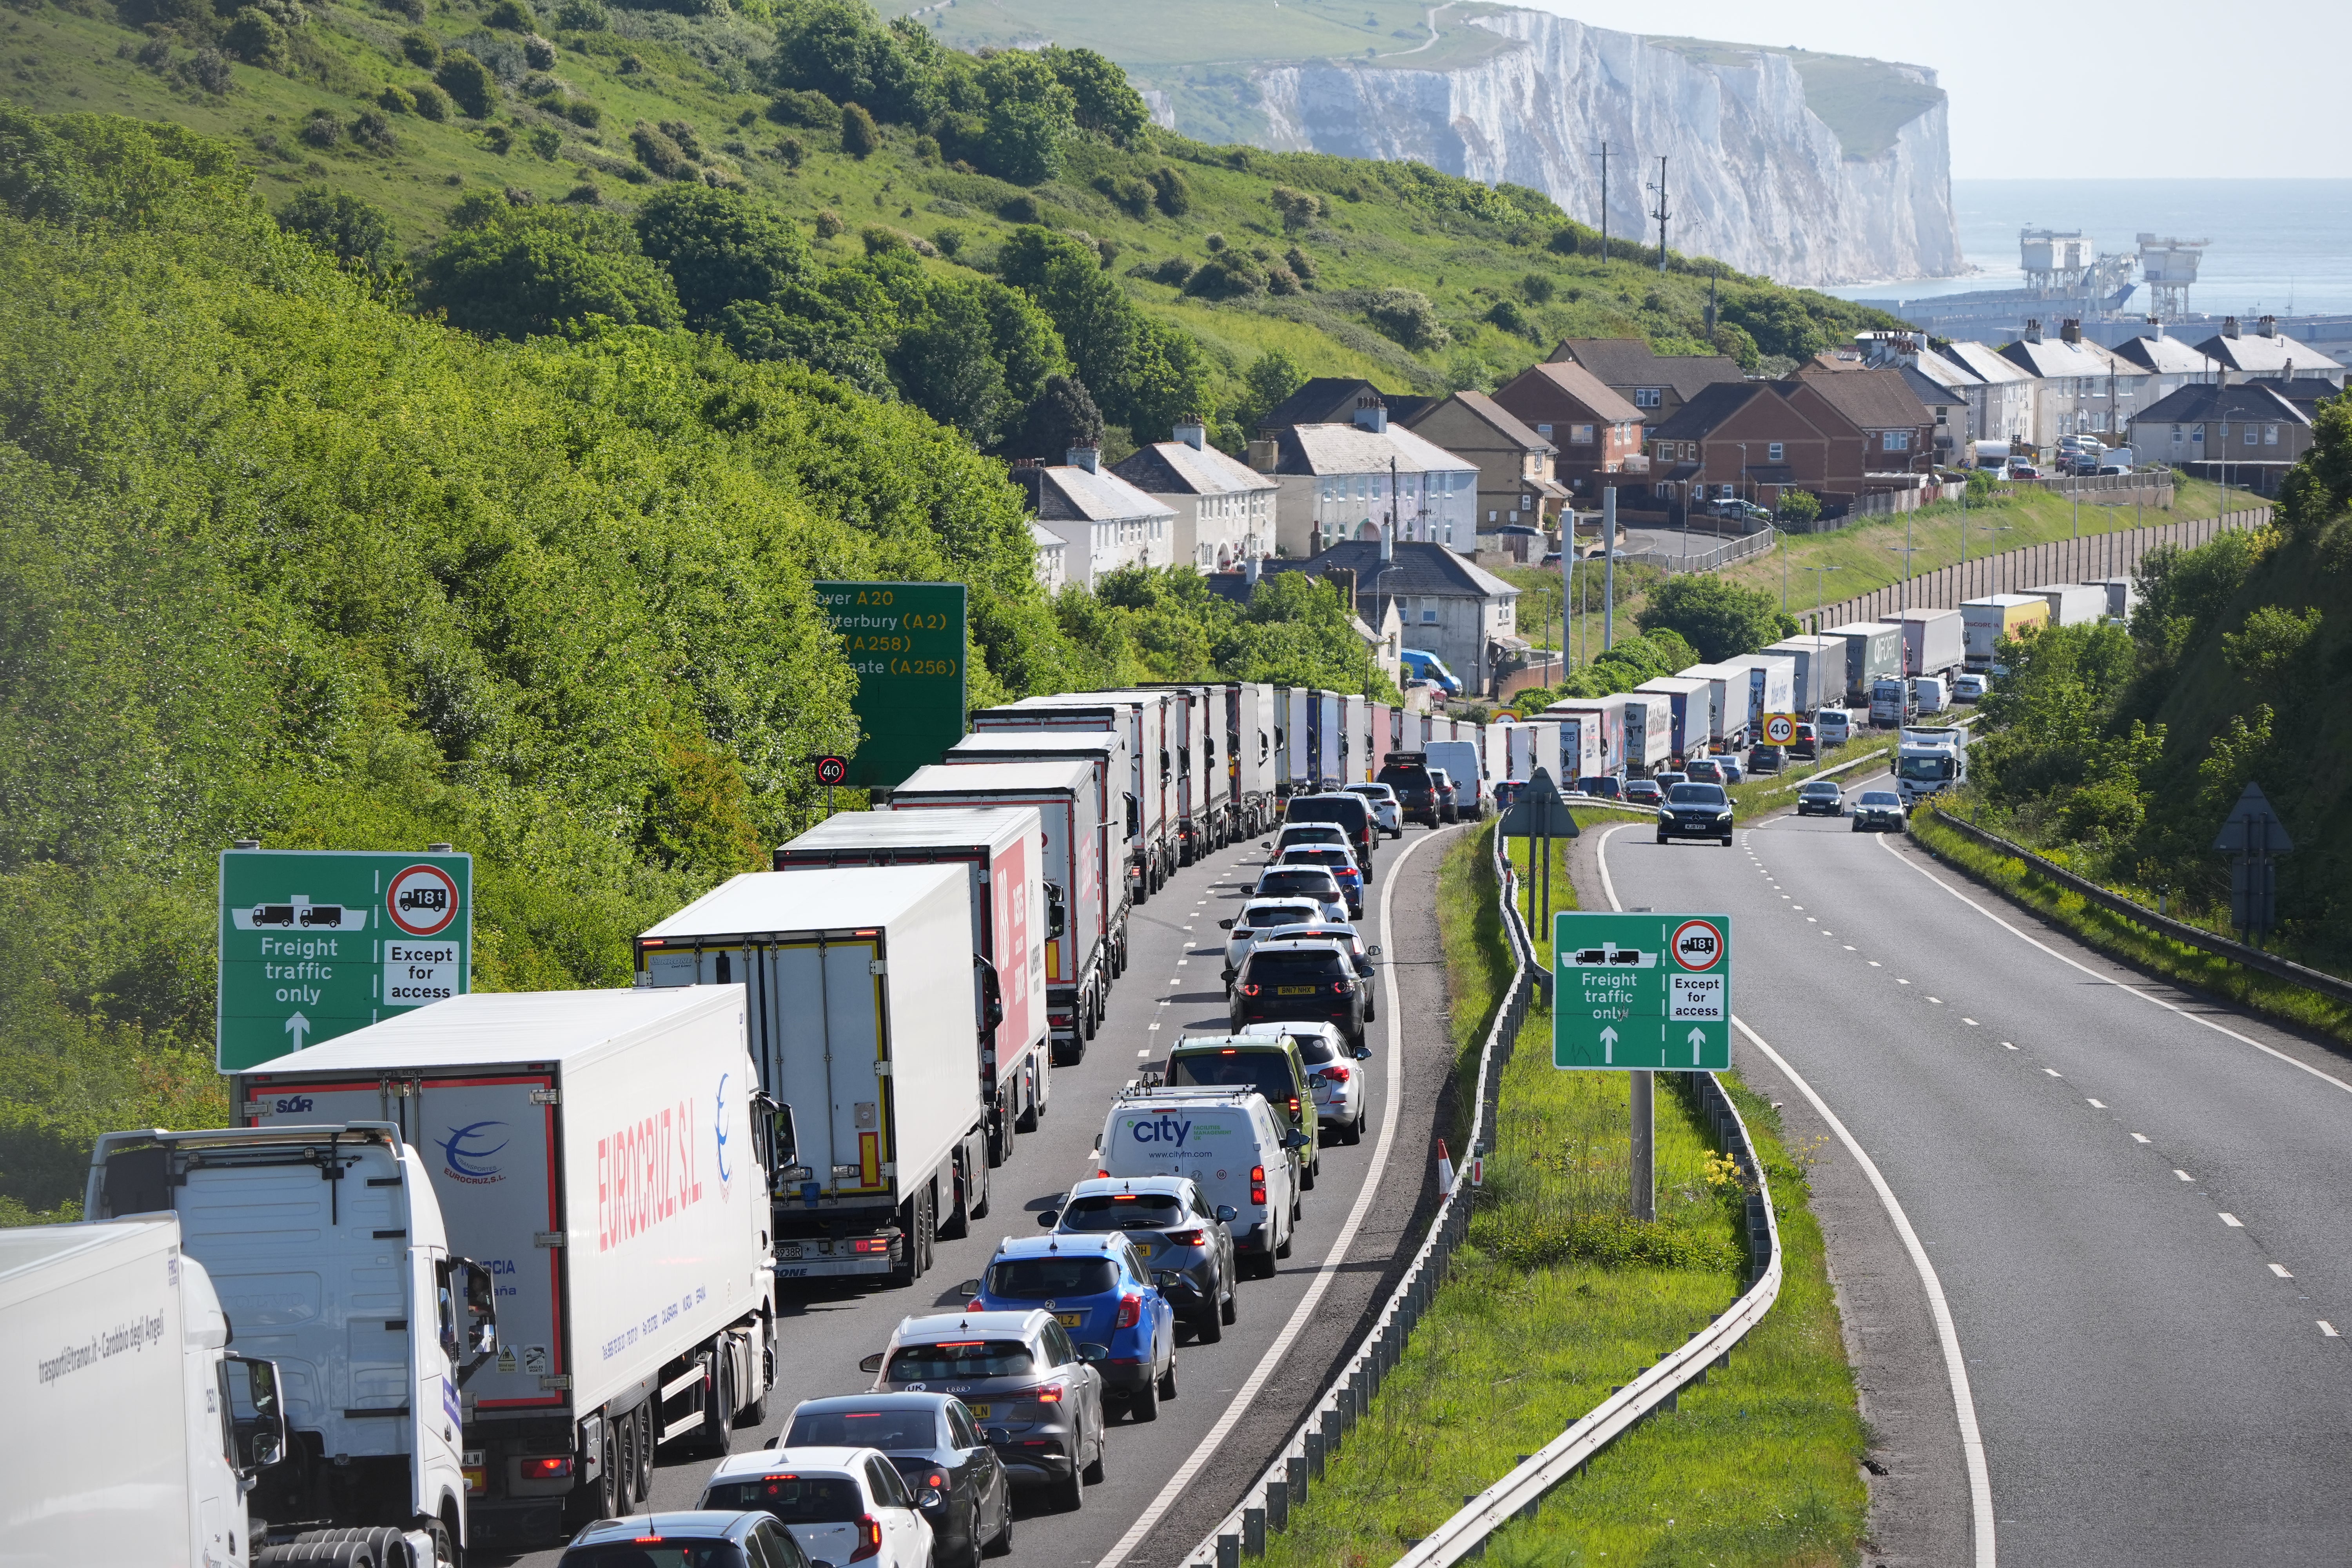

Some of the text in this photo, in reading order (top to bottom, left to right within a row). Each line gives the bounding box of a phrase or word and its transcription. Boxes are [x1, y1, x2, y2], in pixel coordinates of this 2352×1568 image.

[815, 590, 893, 606] over A20
[826, 613, 946, 631] nterbury (A2)
[844, 634, 911, 652] (A258)
[891, 657, 956, 677] (A256)
[1771, 724, 1790, 735] 40
[823, 765, 839, 777] 40
[261, 937, 338, 960] Freight
[392, 947, 453, 964] Except
[265, 962, 332, 980] traffic
[408, 965, 434, 980] for
[1582, 972, 1637, 989] Freight
[1675, 978, 1720, 991] Except
[276, 984, 321, 1005] only
[392, 986, 450, 998] access
[1584, 989, 1634, 1003] traffic
[1688, 992, 1706, 1002] for
[1675, 1007, 1718, 1016] access
[1133, 1115, 1192, 1147] city
[1149, 1151, 1212, 1159] www.cityfm.com
[457, 1157, 497, 1172] TRANSPORTES
[168, 1258, 177, 1276] FRC
[774, 1268, 808, 1278] RONE
[221, 1292, 305, 1308] VOLVO
[102, 1323, 129, 1359] Carobbio
[130, 1315, 144, 1352] degli
[145, 1307, 164, 1346] Angeli
